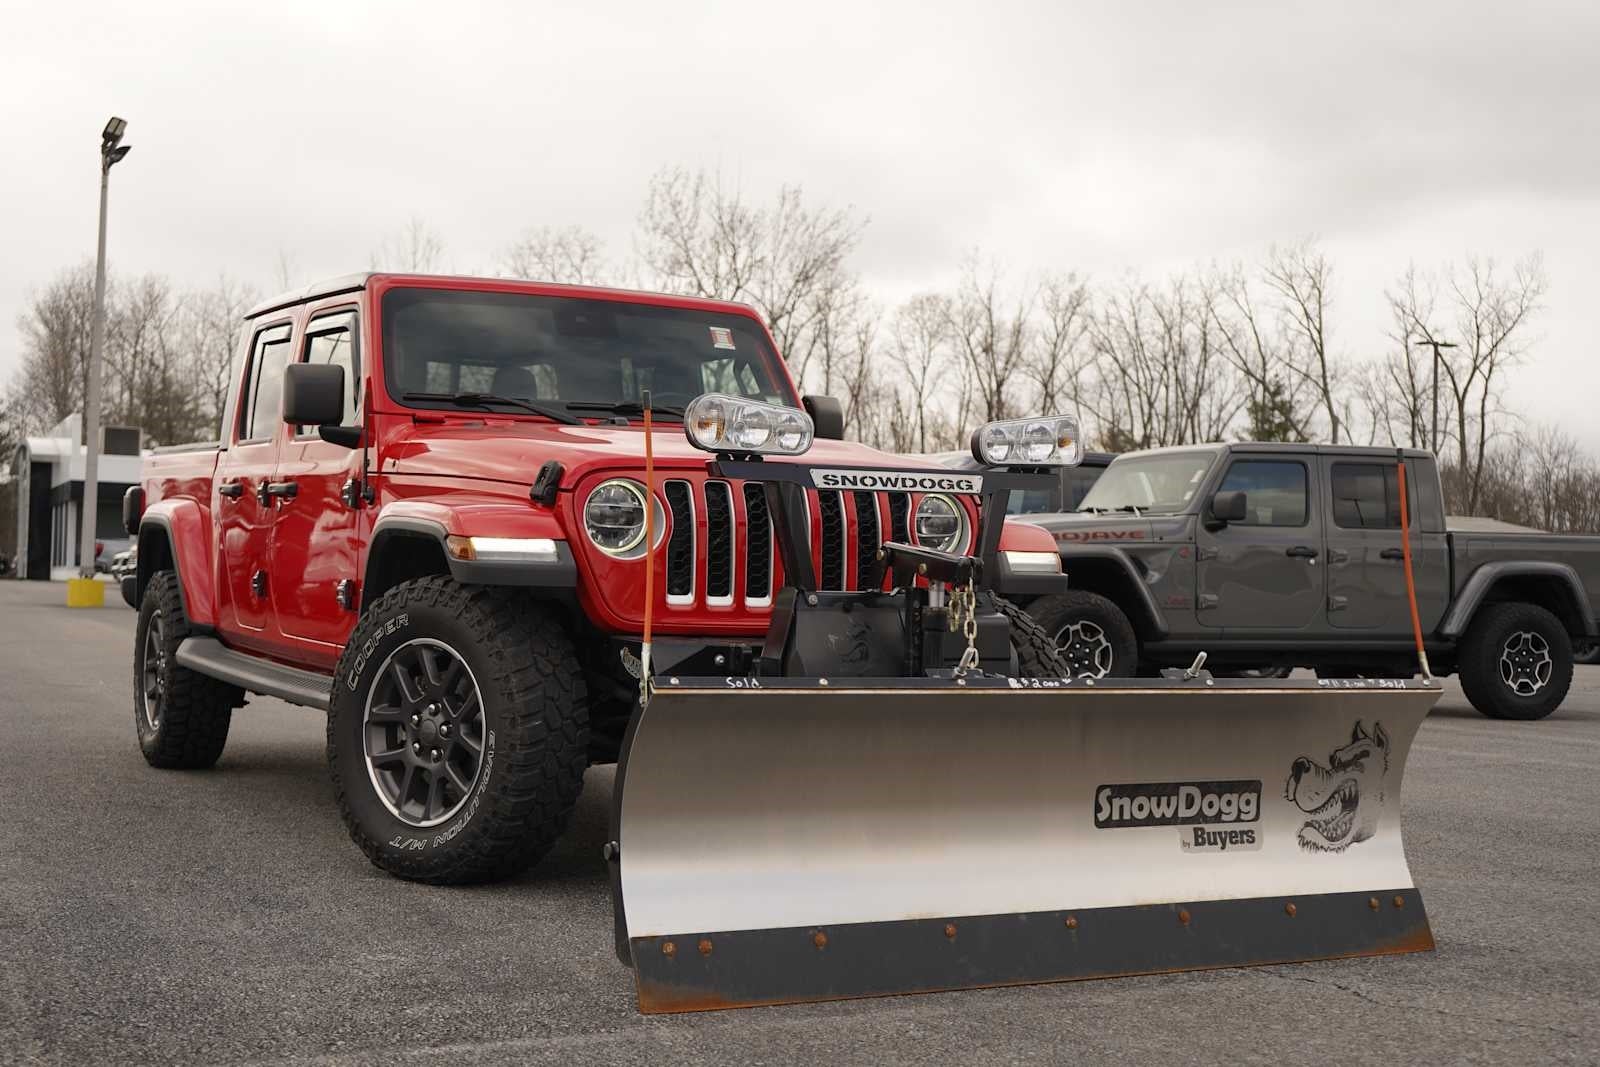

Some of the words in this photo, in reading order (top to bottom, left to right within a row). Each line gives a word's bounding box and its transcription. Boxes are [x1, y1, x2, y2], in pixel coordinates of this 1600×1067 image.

[822, 474, 974, 491] SNOWDOGG
[347, 613, 409, 691] COOPER
[433, 729, 495, 848] EVOLUTION
[1096, 786, 1258, 821] SnowDogg
[389, 834, 428, 850] M/T
[1193, 827, 1256, 850] Buyers
